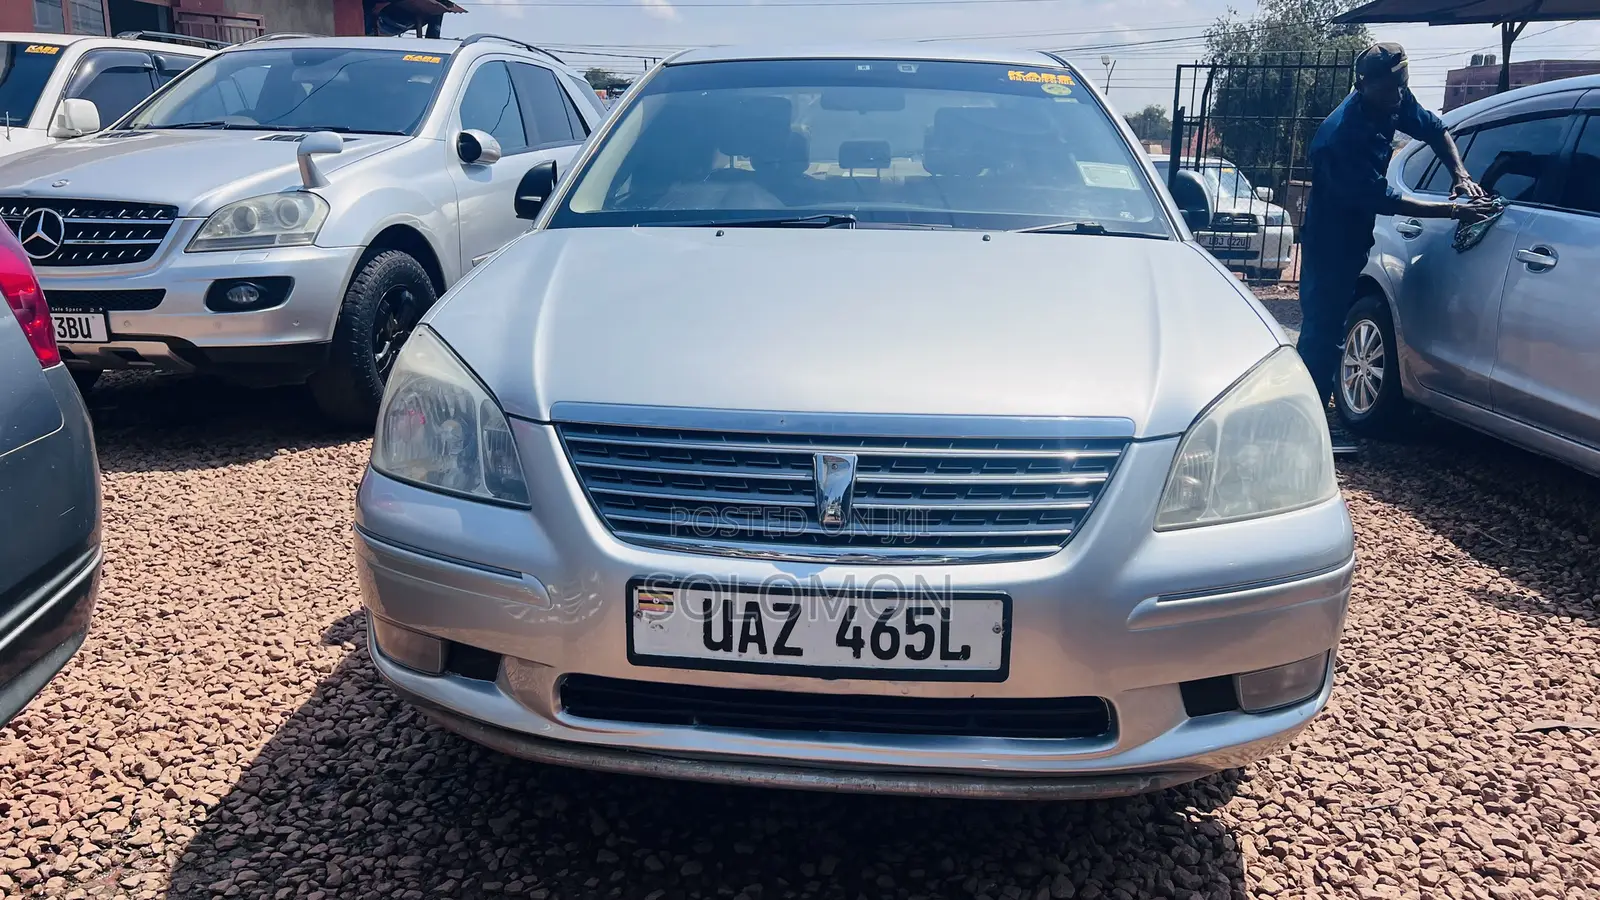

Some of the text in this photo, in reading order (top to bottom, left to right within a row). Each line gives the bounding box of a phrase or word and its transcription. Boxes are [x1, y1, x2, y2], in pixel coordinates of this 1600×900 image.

[50, 316, 92, 339] 3BU
[702, 597, 972, 662] UAZ 465L
